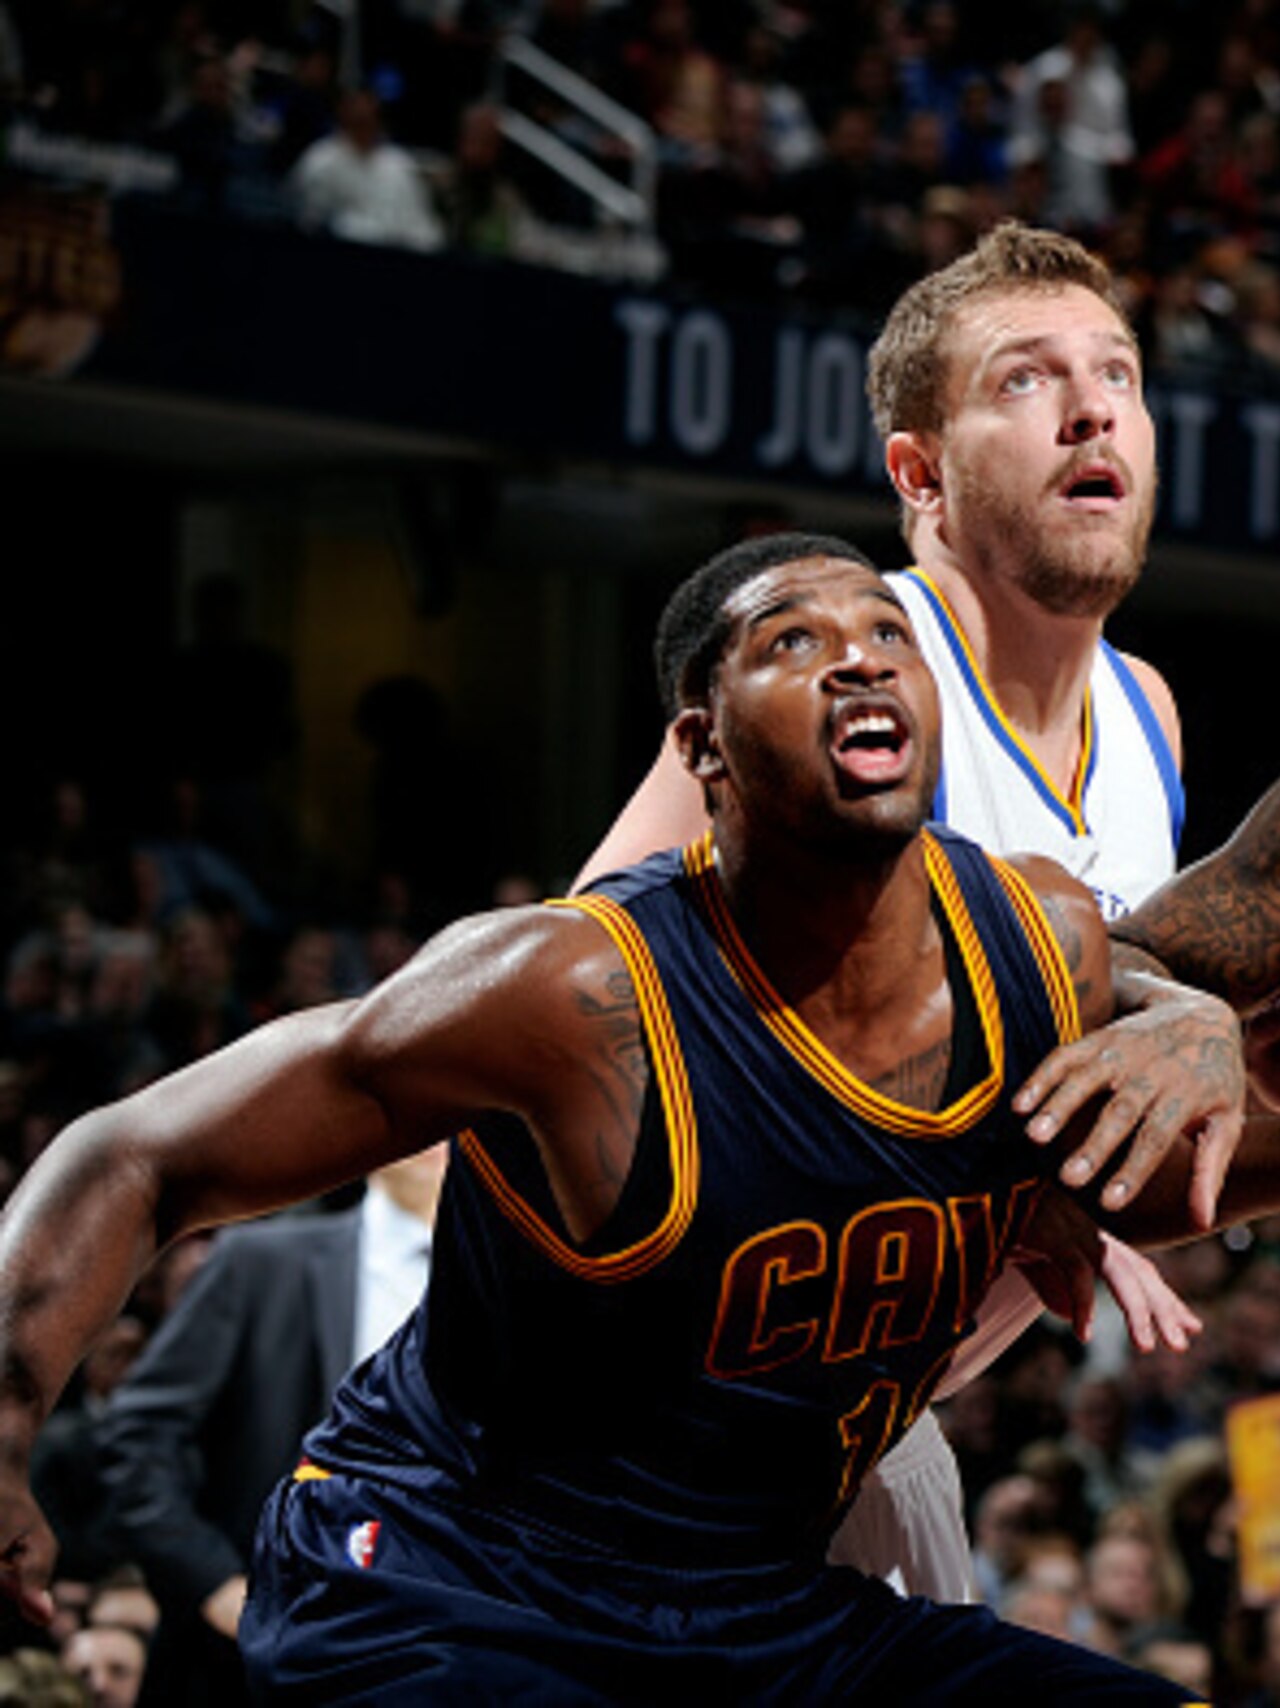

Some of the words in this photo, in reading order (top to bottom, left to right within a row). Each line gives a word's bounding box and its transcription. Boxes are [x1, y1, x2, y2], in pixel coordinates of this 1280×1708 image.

[614, 300, 731, 454] TO
[756, 329, 885, 482] JO
[838, 1350, 955, 1502] 1
